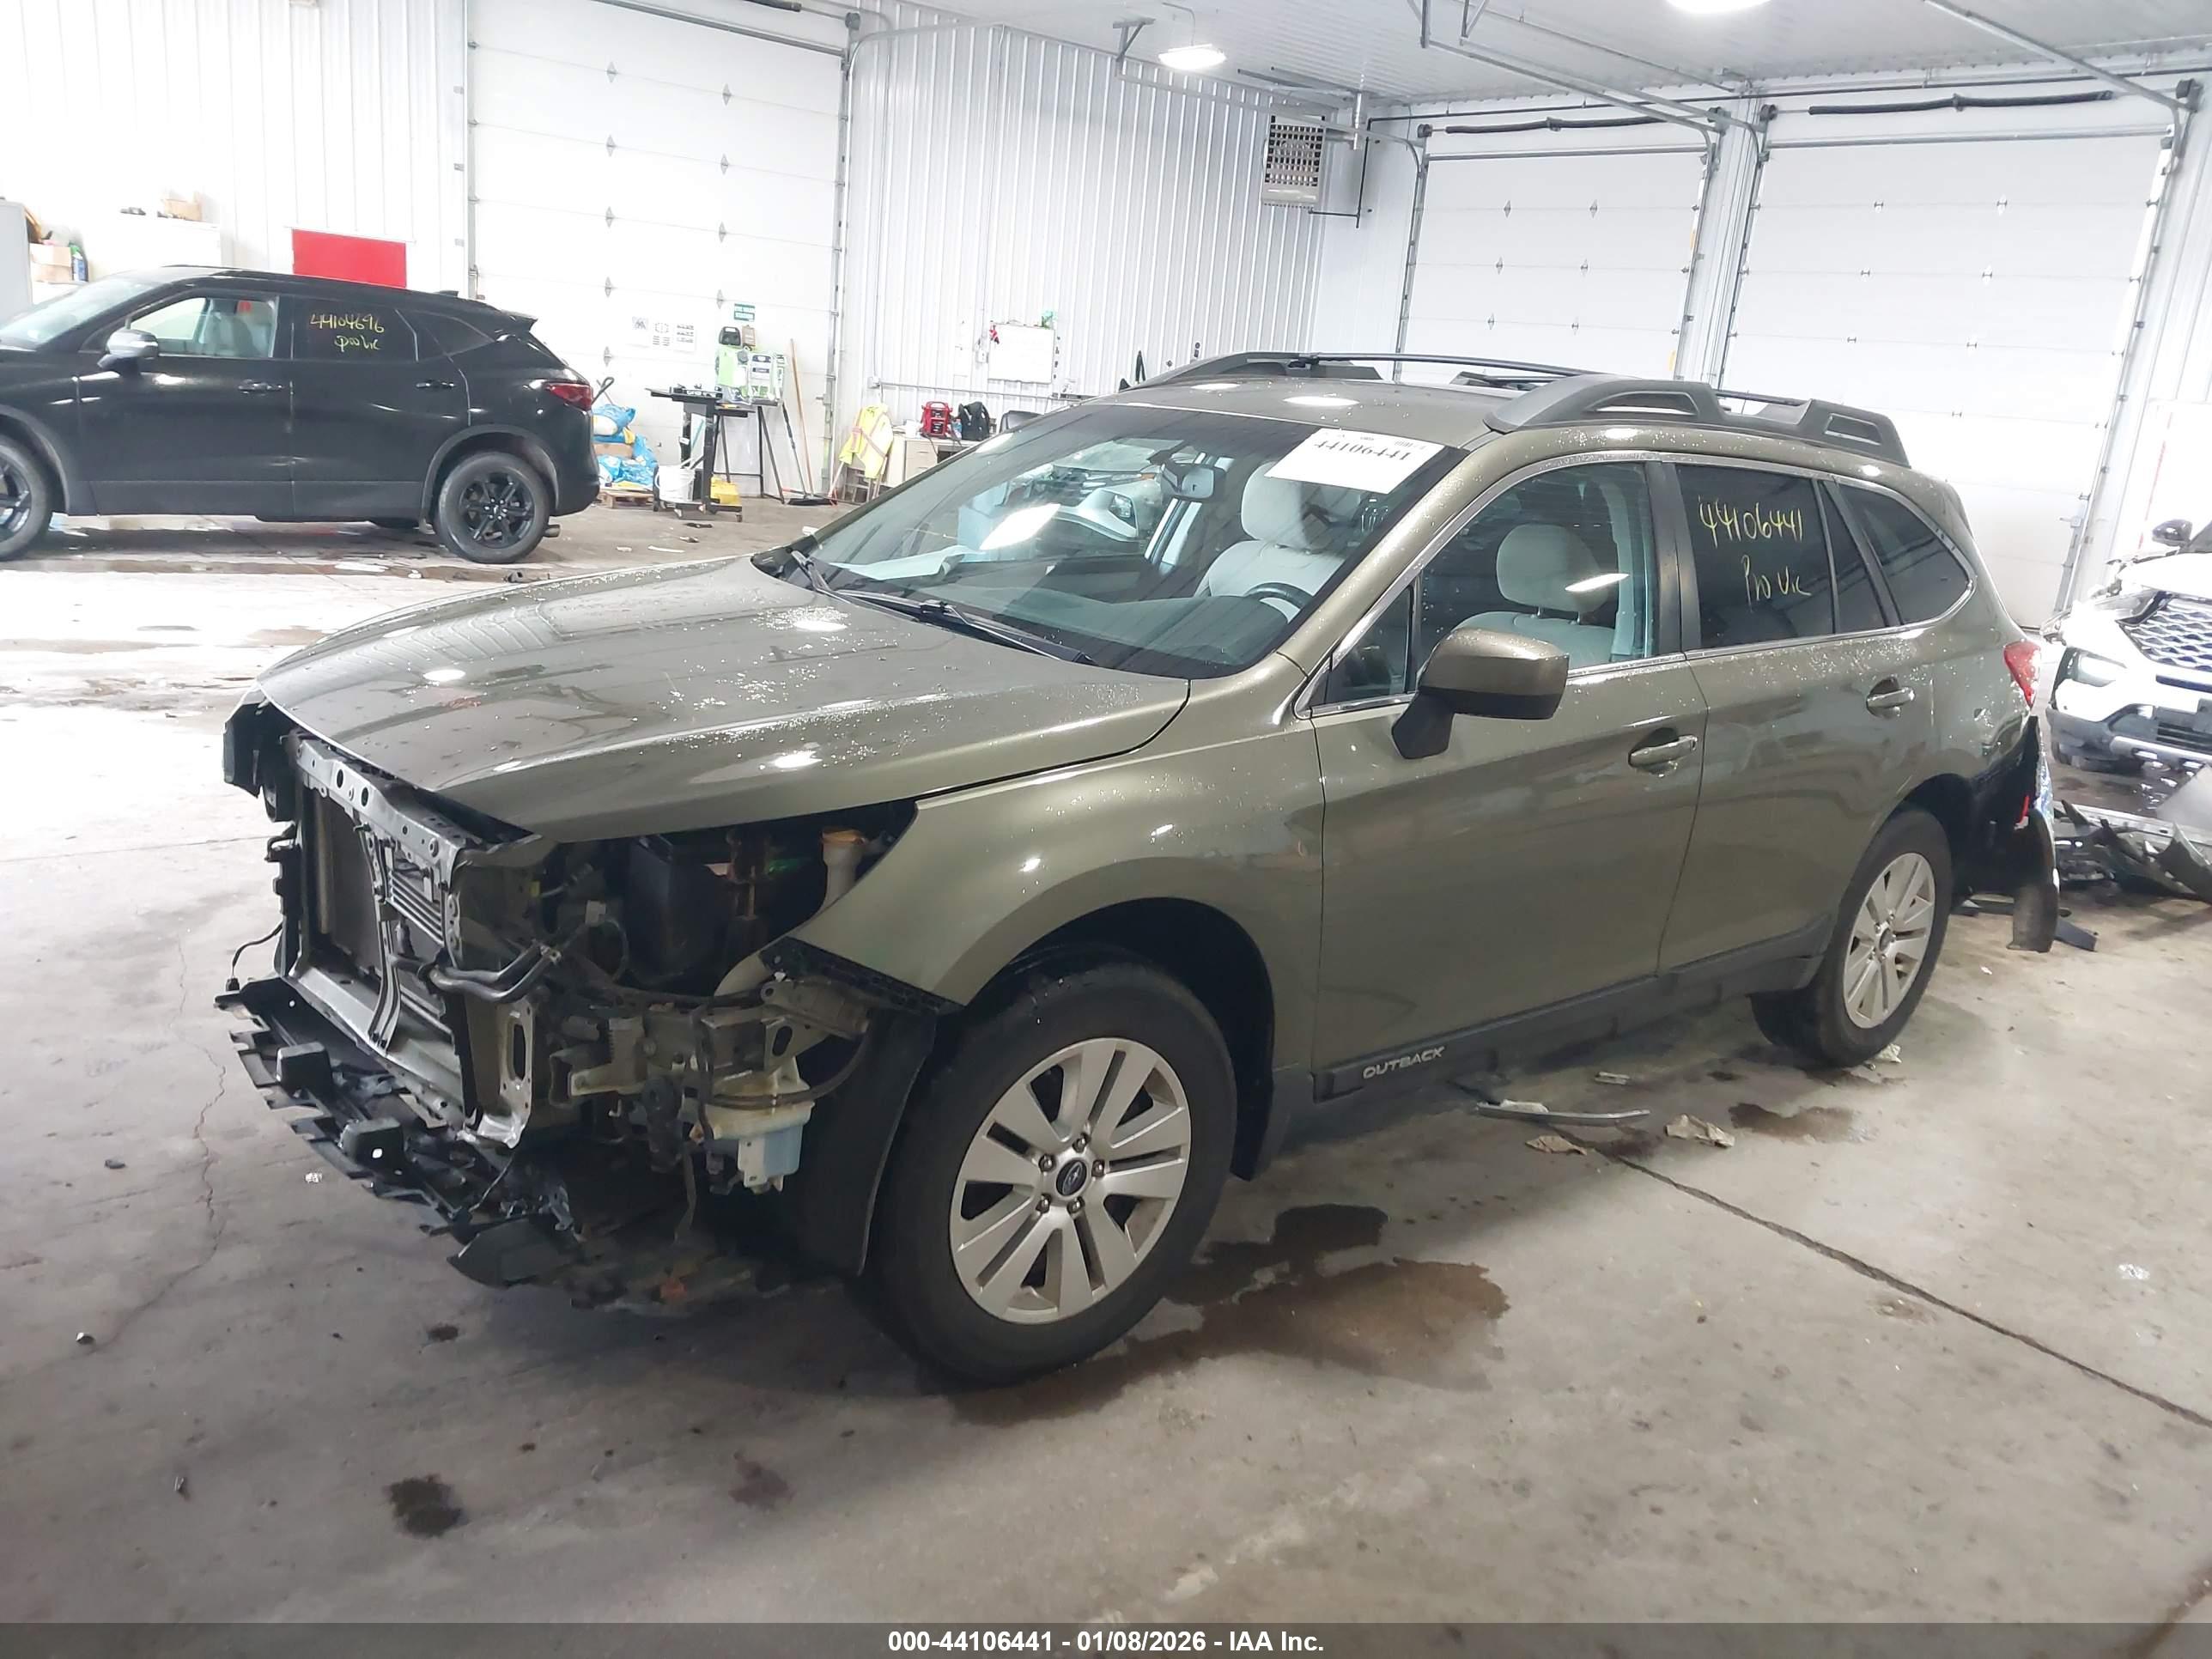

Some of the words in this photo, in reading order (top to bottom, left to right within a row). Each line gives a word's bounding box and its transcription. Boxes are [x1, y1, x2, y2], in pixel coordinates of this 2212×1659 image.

[309, 313, 386, 333] 44104696
[1314, 440, 1412, 460] 44106441
[1698, 495, 1802, 549] 44106441
[1363, 1046, 1445, 1079] OUTBACK
